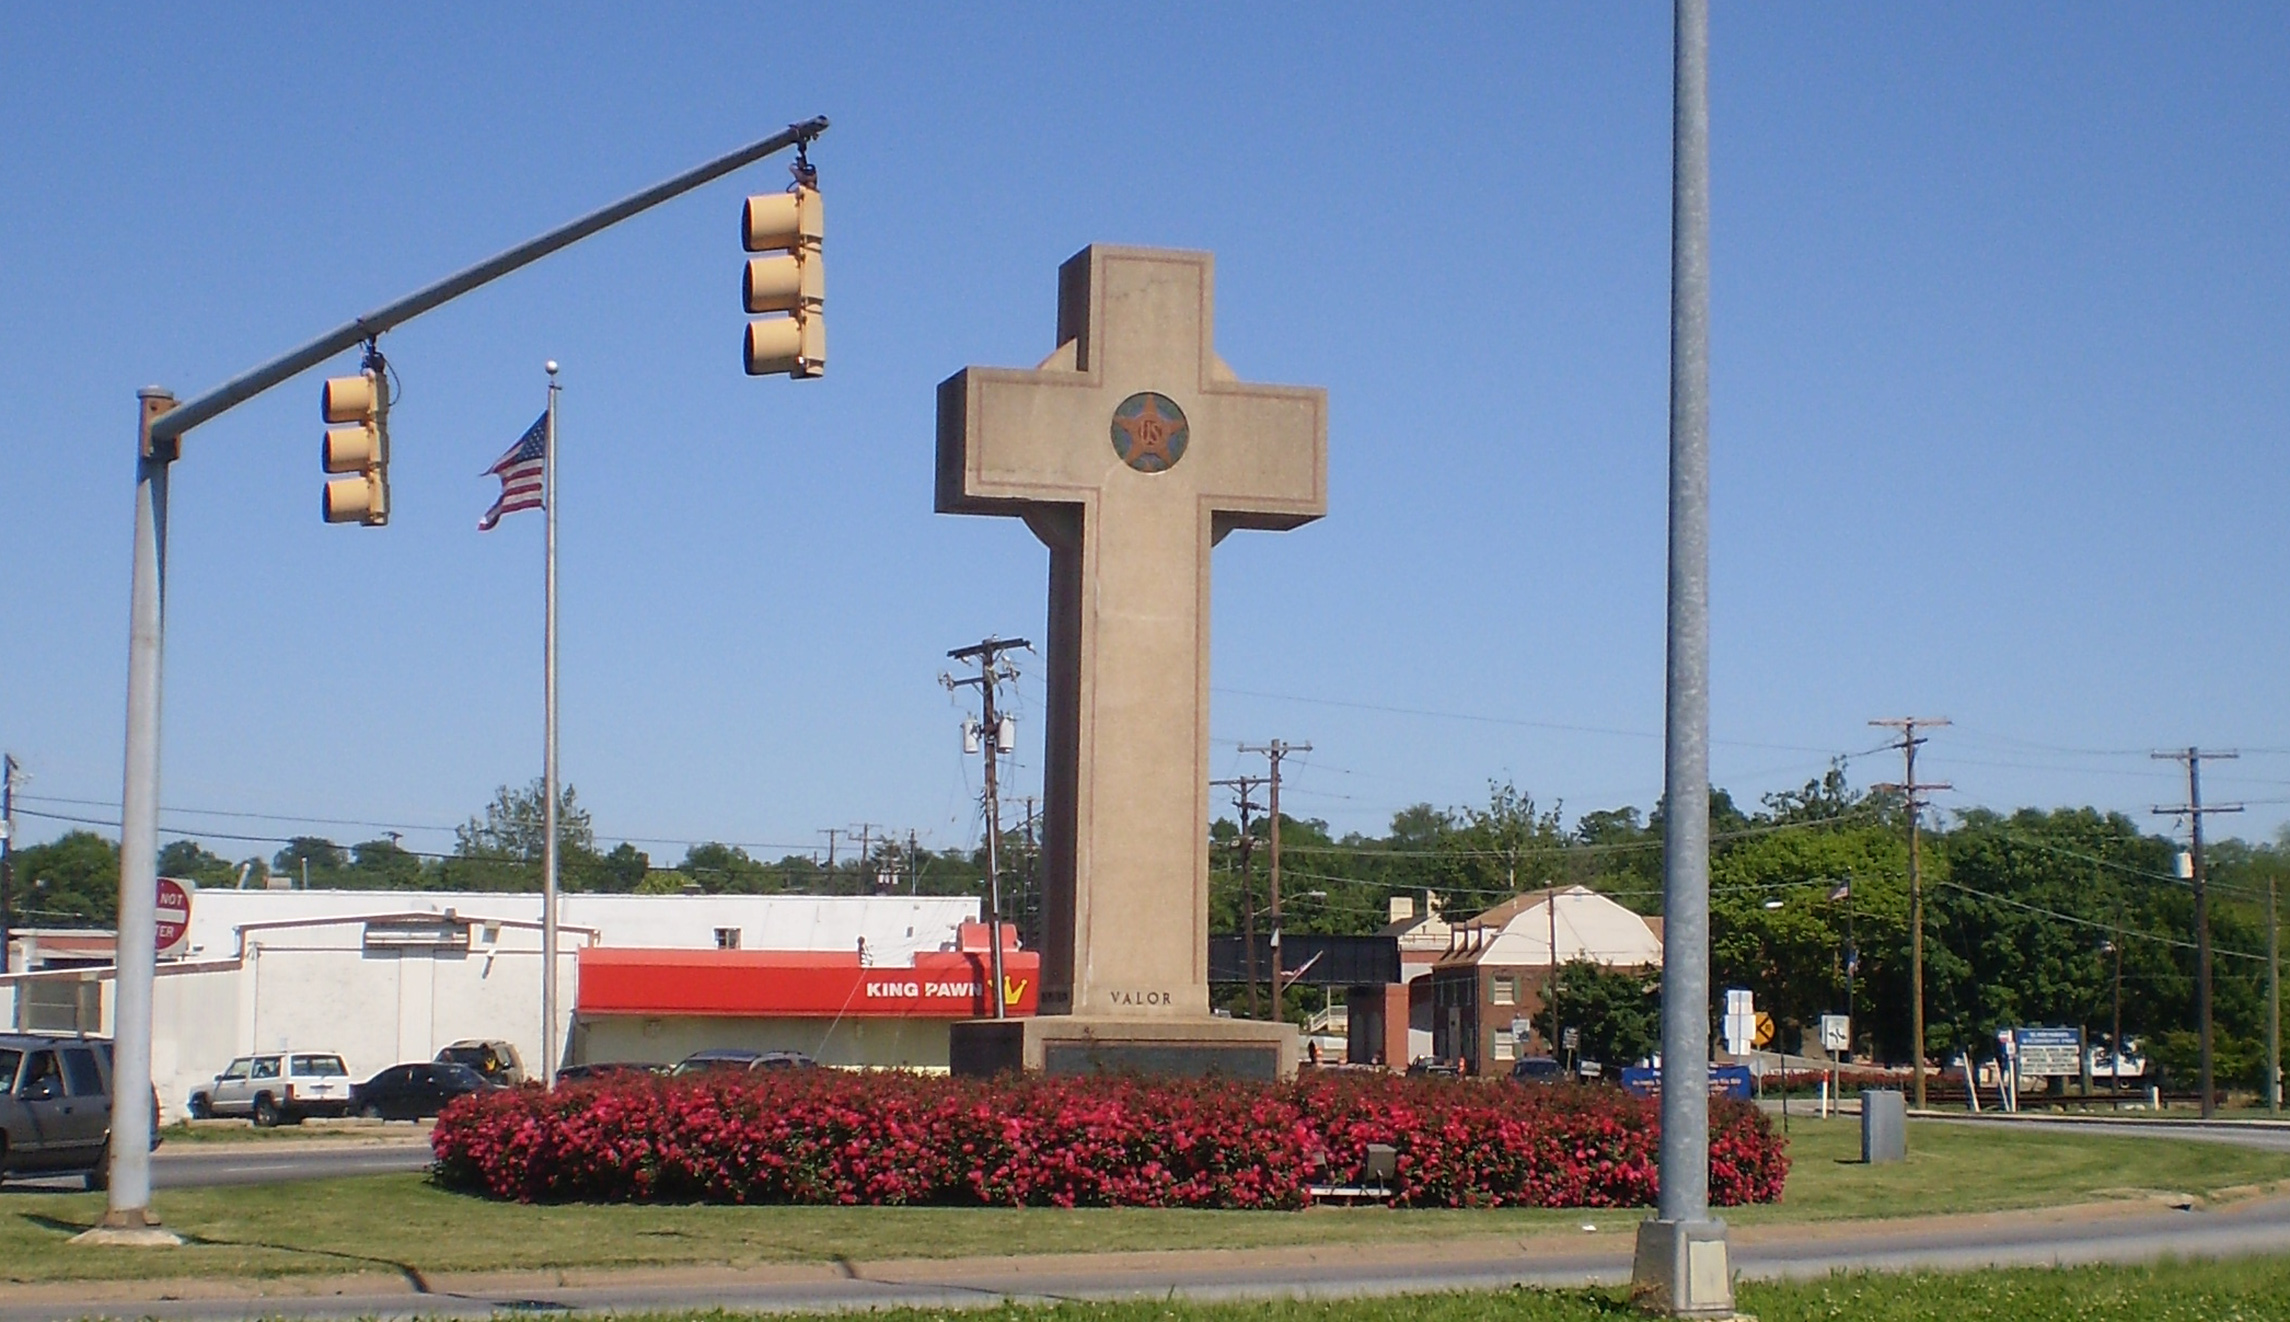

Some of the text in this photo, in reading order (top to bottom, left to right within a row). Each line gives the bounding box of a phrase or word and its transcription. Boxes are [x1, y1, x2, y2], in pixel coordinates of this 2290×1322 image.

[160, 893, 183, 906] NOT
[155, 924, 174, 938] TER
[866, 982, 983, 997] KING PAWN
[1110, 991, 1171, 1005] VALOR
